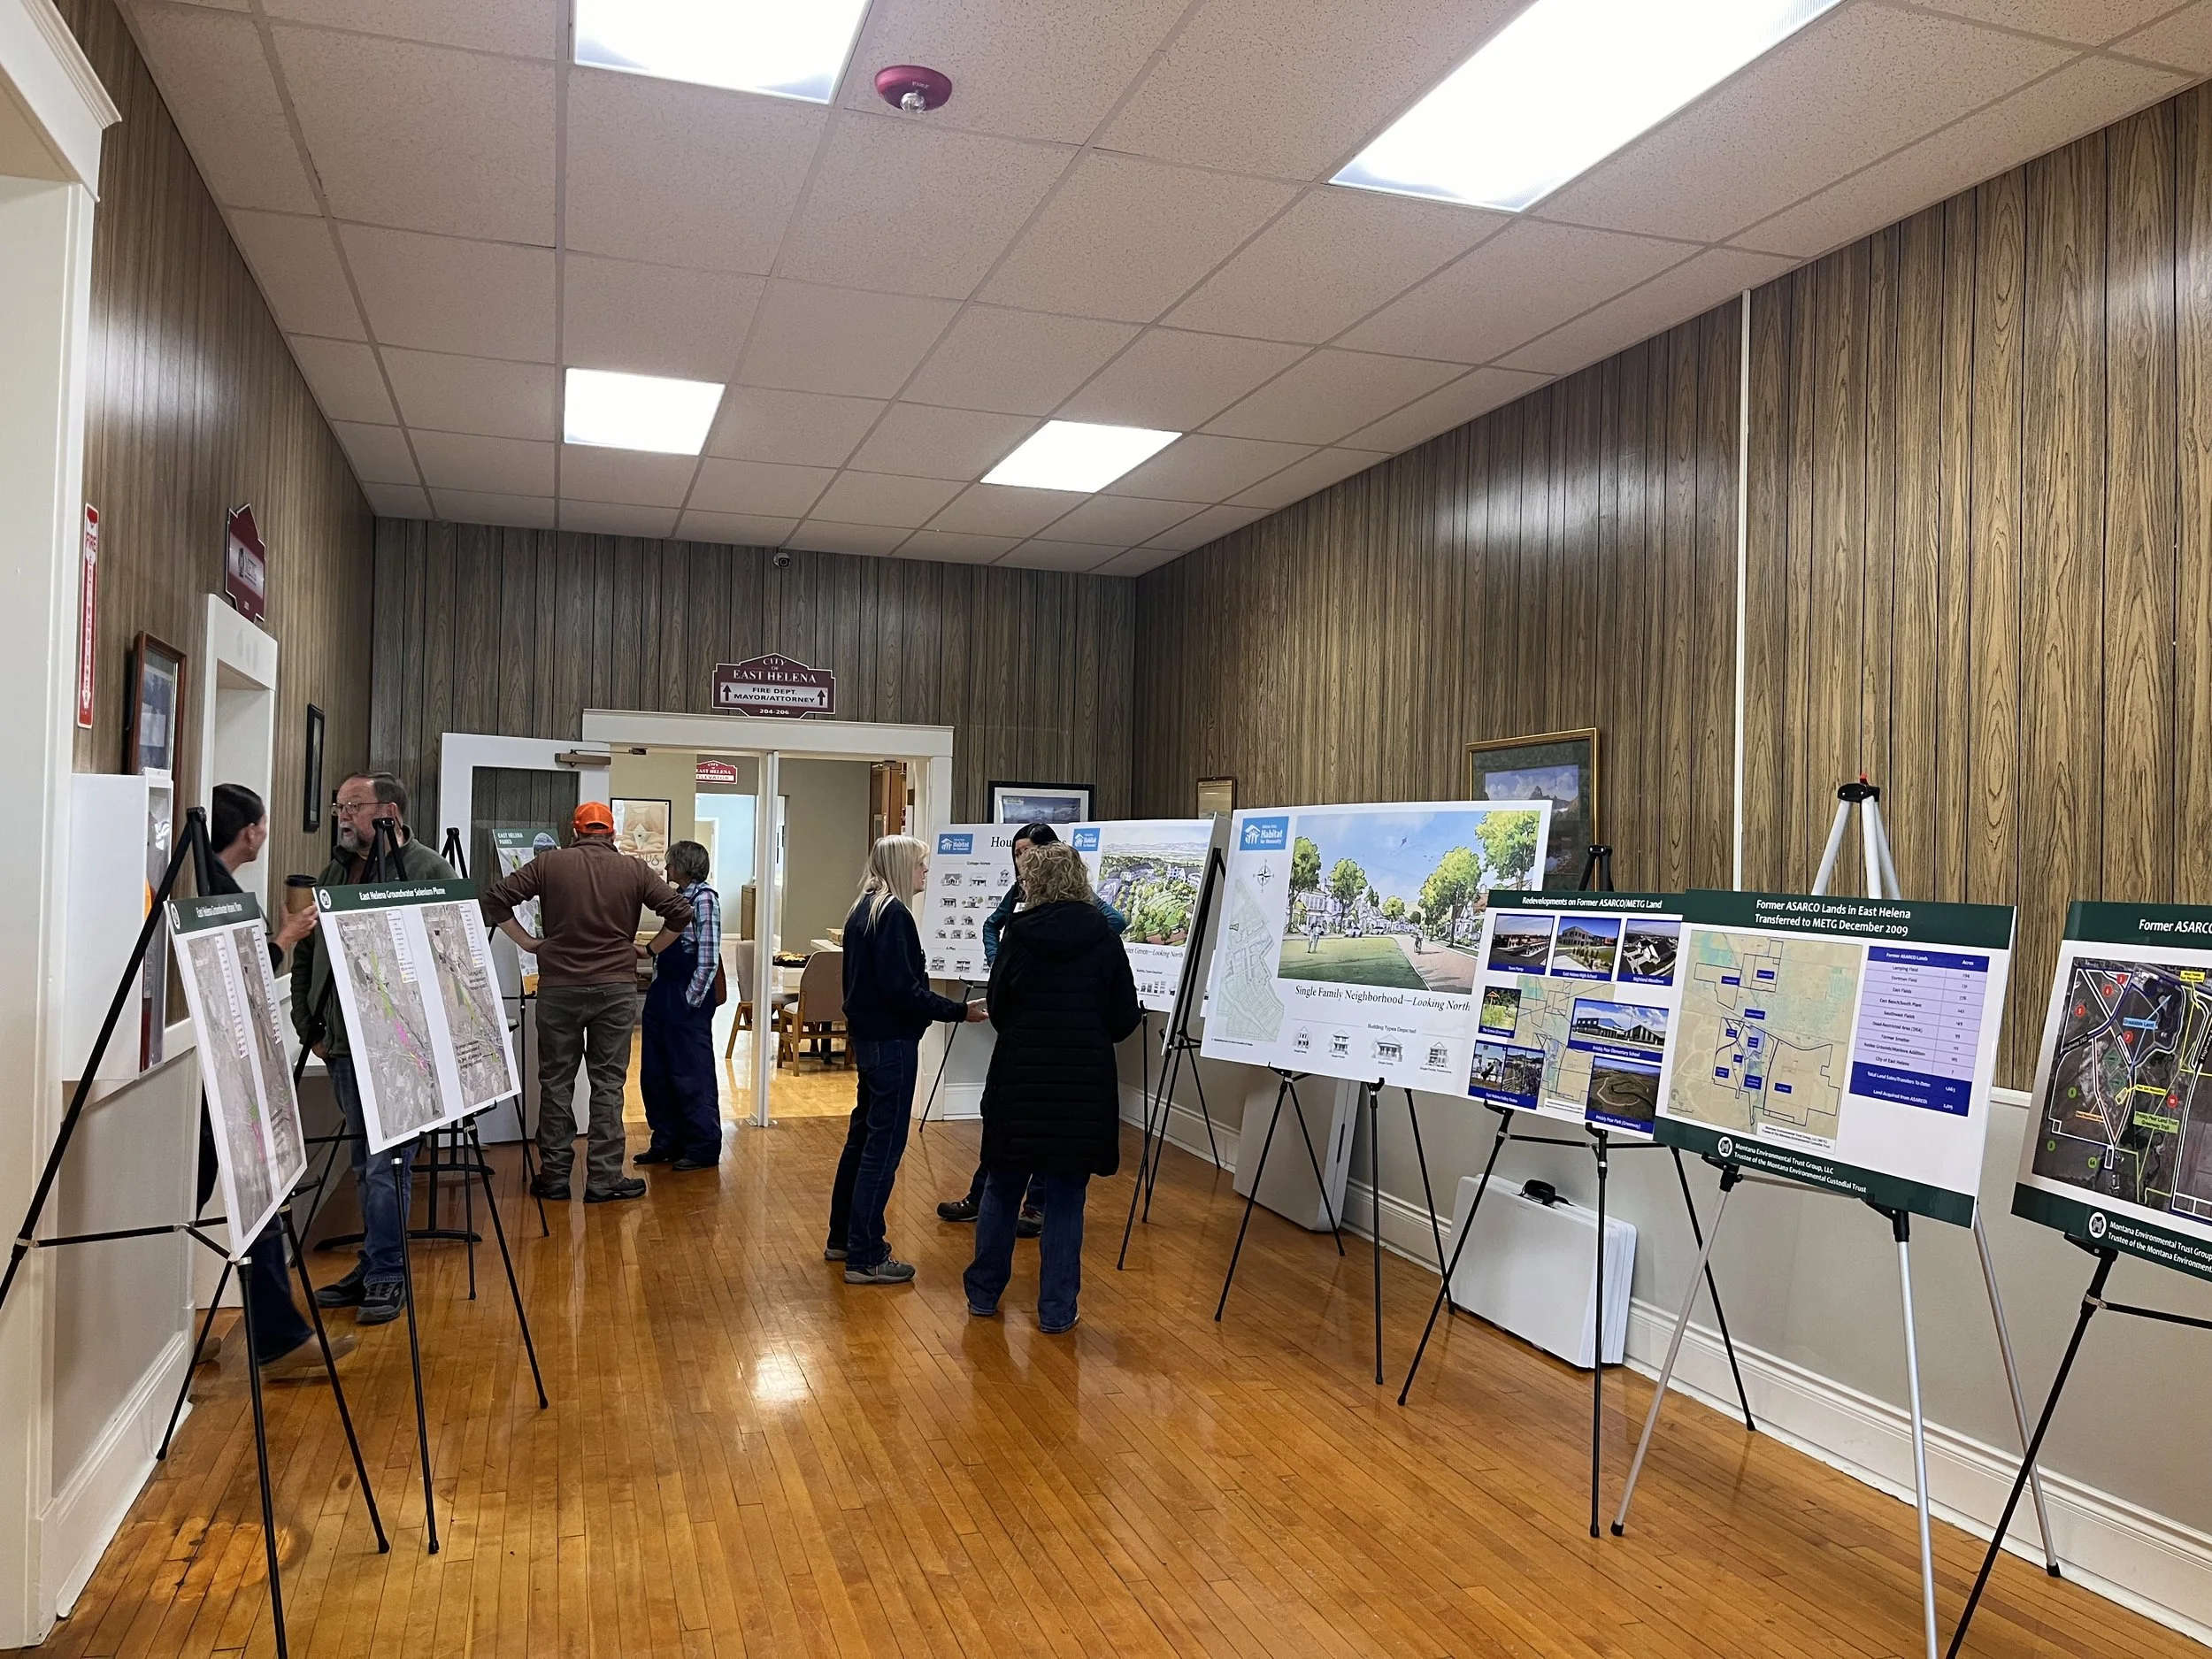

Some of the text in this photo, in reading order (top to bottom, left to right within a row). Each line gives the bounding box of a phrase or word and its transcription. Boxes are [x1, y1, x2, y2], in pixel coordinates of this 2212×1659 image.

[912, 81, 931, 89] FIRE
[733, 669, 817, 684] EAST HELENA
[734, 693, 815, 703] MAYOR/ATTORNEY
[1261, 829, 1283, 838] Habitat
[359, 892, 370, 900] East
[371, 891, 386, 900] Helena
[386, 889, 414, 899] Groundwater
[1522, 897, 1567, 906] Redevelopments
[1577, 899, 1598, 907] Former
[1599, 899, 1645, 908] ASARCO/METG
[1646, 900, 1663, 909] Land
[1756, 899, 1911, 919] Former ASARCO Lands in East Helena
[1755, 914, 1909, 937] Transferred to METG December 2009
[2139, 919, 2174, 932] Former
[1295, 985, 1317, 998] Single
[1318, 987, 1343, 1001] Family
[1446, 1000, 1470, 1011] North
[1735, 1143, 1834, 1174] Montana Environmental Trust Group, LLC
[1734, 1152, 1751, 1162] Trustee
[1767, 1161, 1788, 1172] Montana
[1789, 1166, 1826, 1182] Environmental
[1827, 1177, 1851, 1189] Custodial
[1852, 1183, 1866, 1193] Trust
[2110, 1221, 2134, 1235] Montana
[2135, 1229, 2176, 1248] Environmental
[2178, 1243, 2193, 1254] Trust
[2108, 1232, 2128, 1245] Trustee
[2137, 1241, 2146, 1251] the
[2147, 1245, 2172, 1260] Montana
[2173, 1254, 2212, 1273] Environment
